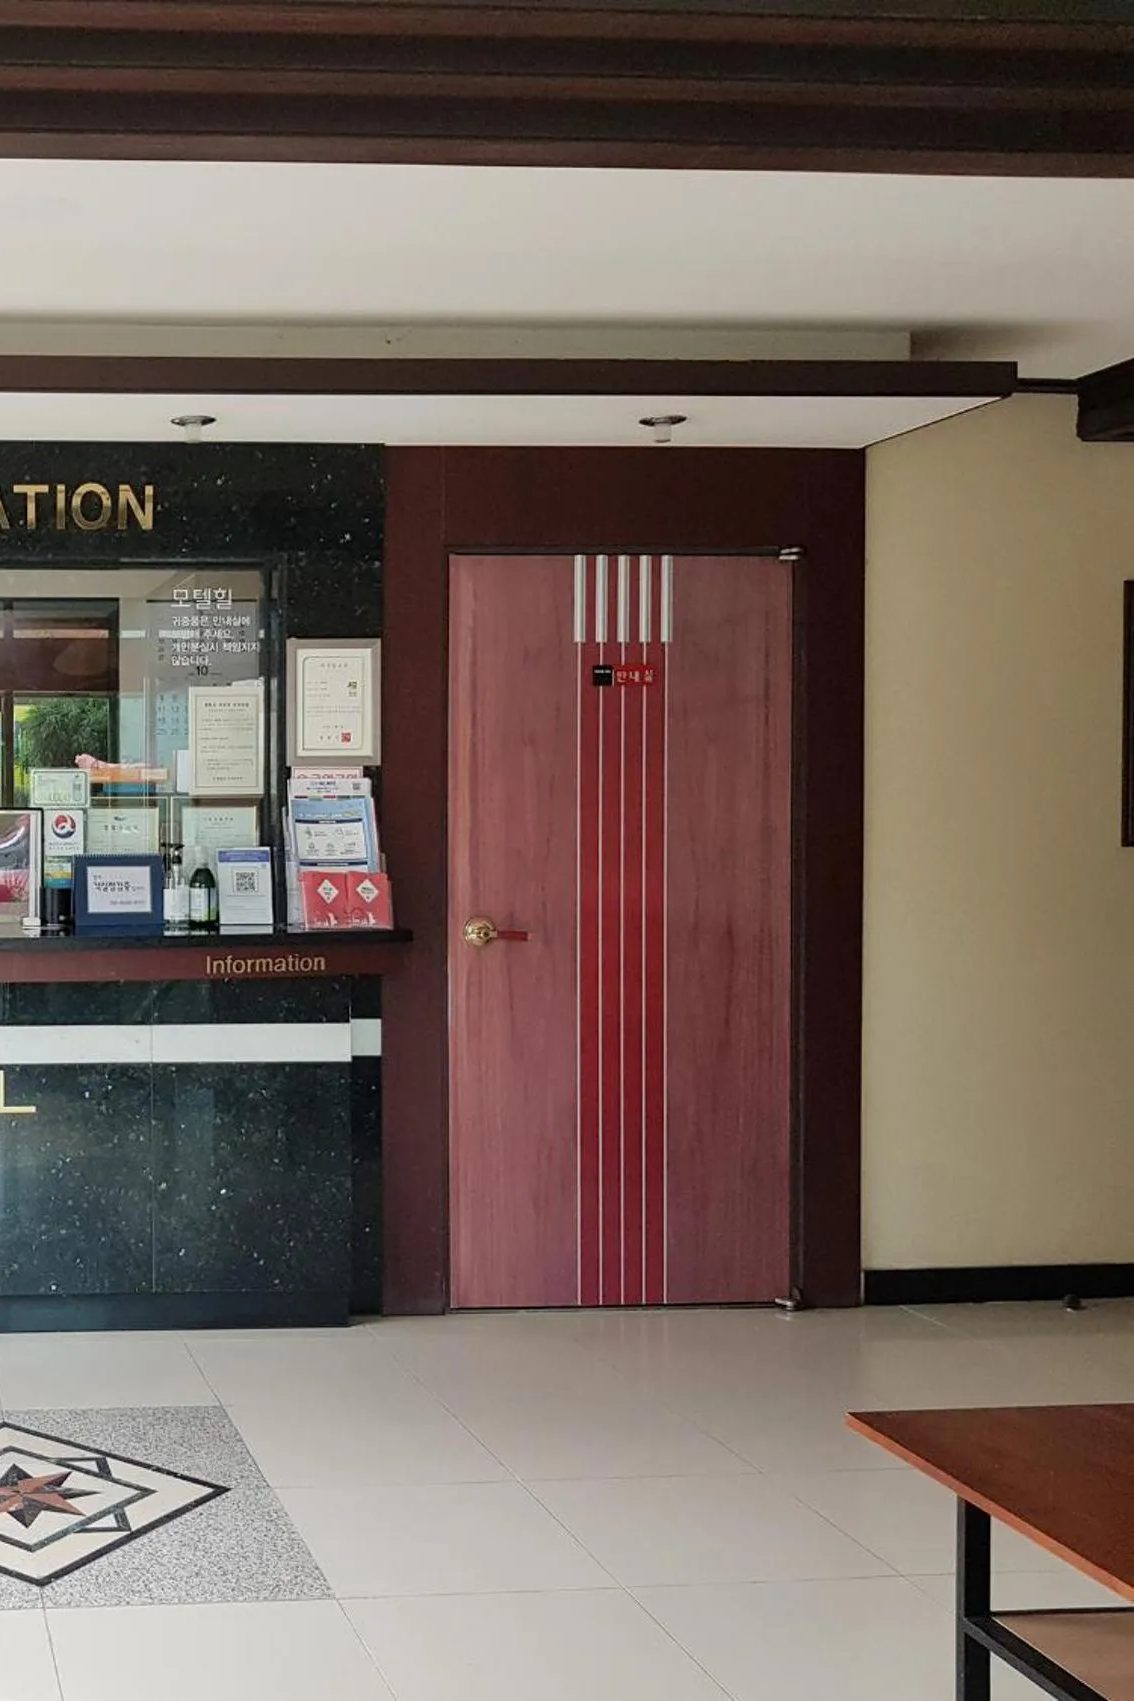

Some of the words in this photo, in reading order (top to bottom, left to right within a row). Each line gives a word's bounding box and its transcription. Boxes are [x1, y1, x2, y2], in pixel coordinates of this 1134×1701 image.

[170, 587, 232, 610] 모텔힐
[171, 615, 209, 627] 귀중품은
[212, 615, 250, 627] 안내실에
[171, 655, 212, 666] 않습니다.
[196, 665, 209, 676] 10
[617, 669, 654, 683] 안내실
[206, 954, 326, 975] Information
